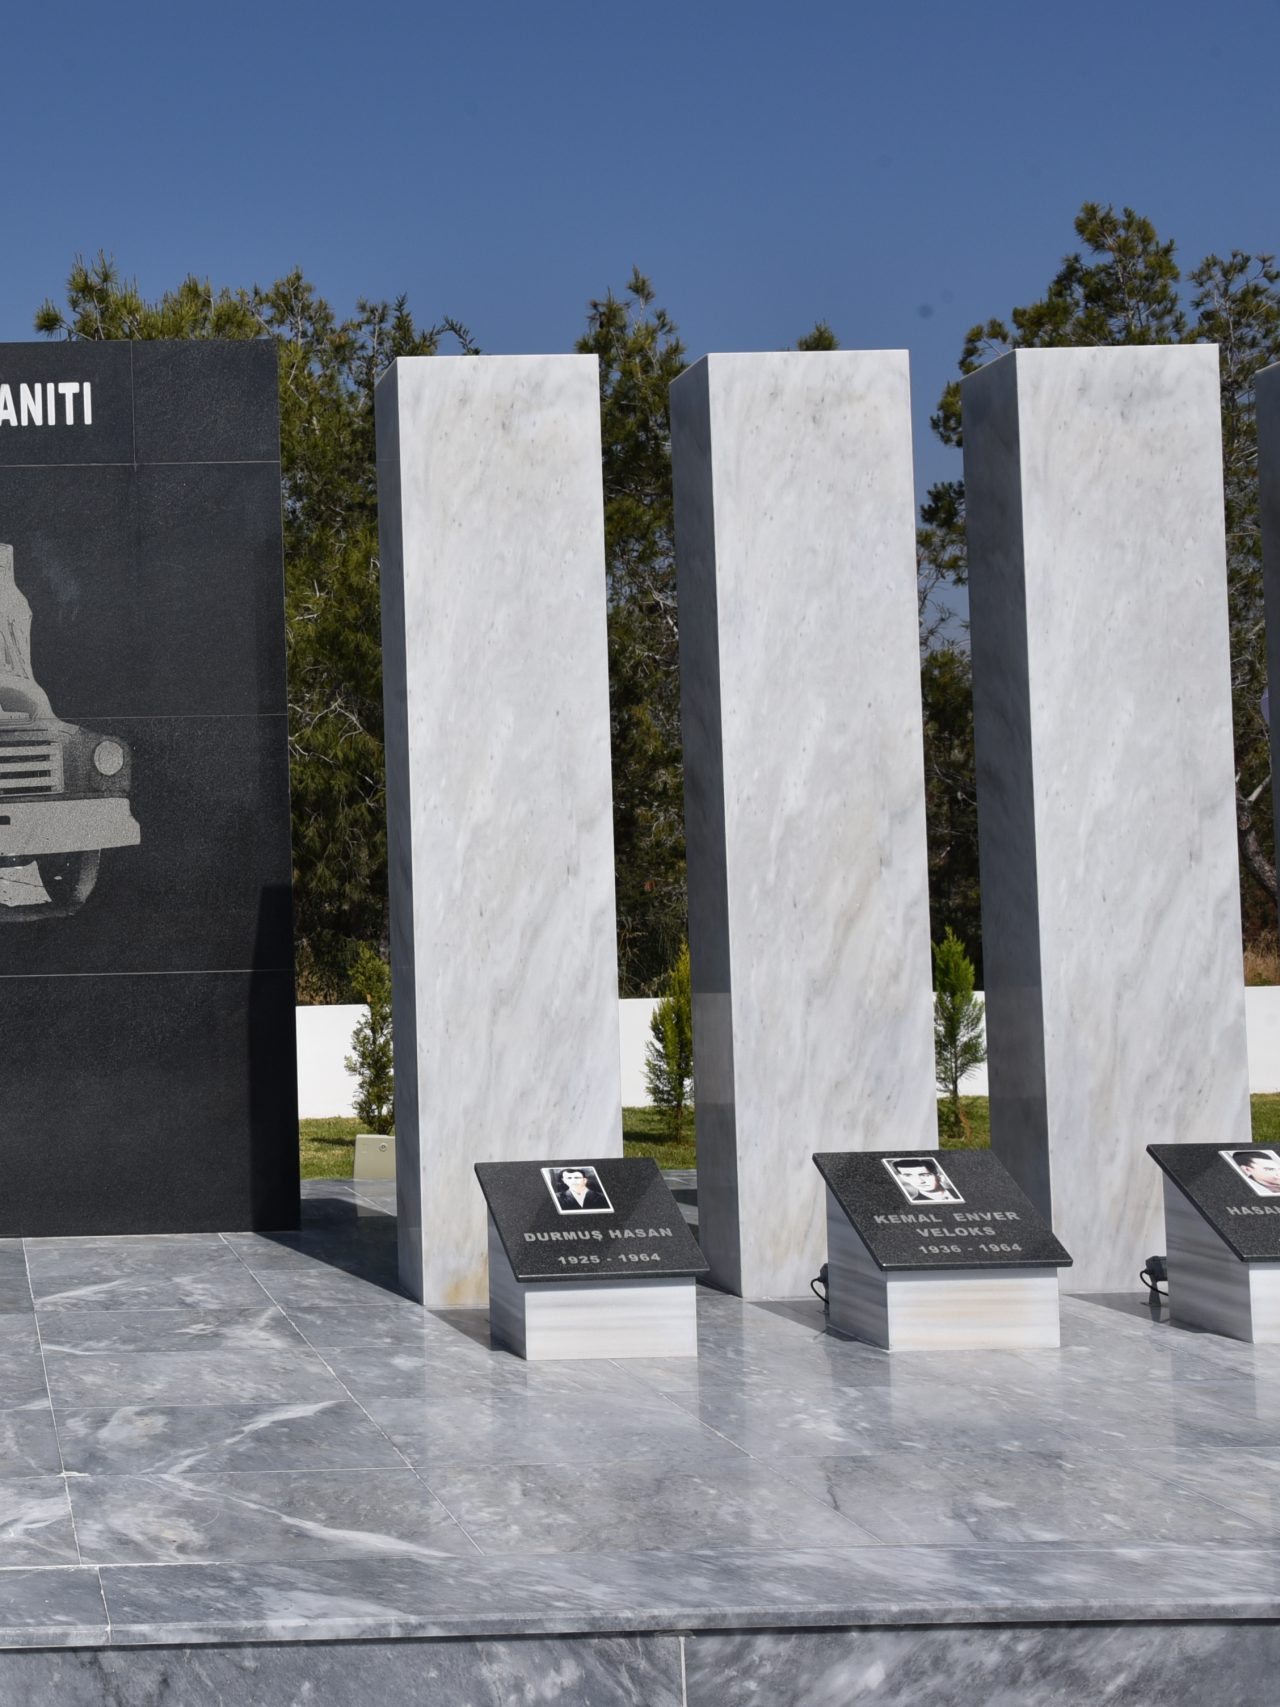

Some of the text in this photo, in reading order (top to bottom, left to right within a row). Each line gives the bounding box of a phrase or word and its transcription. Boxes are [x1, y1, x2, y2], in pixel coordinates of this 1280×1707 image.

[873, 1211, 1020, 1224] KEMAL ENVER
[523, 1228, 673, 1242] DURMUŞ HASAN
[916, 1226, 996, 1238] VELOKS
[919, 1244, 961, 1255] 1936
[978, 1243, 1022, 1253] 1964
[558, 1255, 600, 1265] 1925
[618, 1253, 661, 1263] 1964
